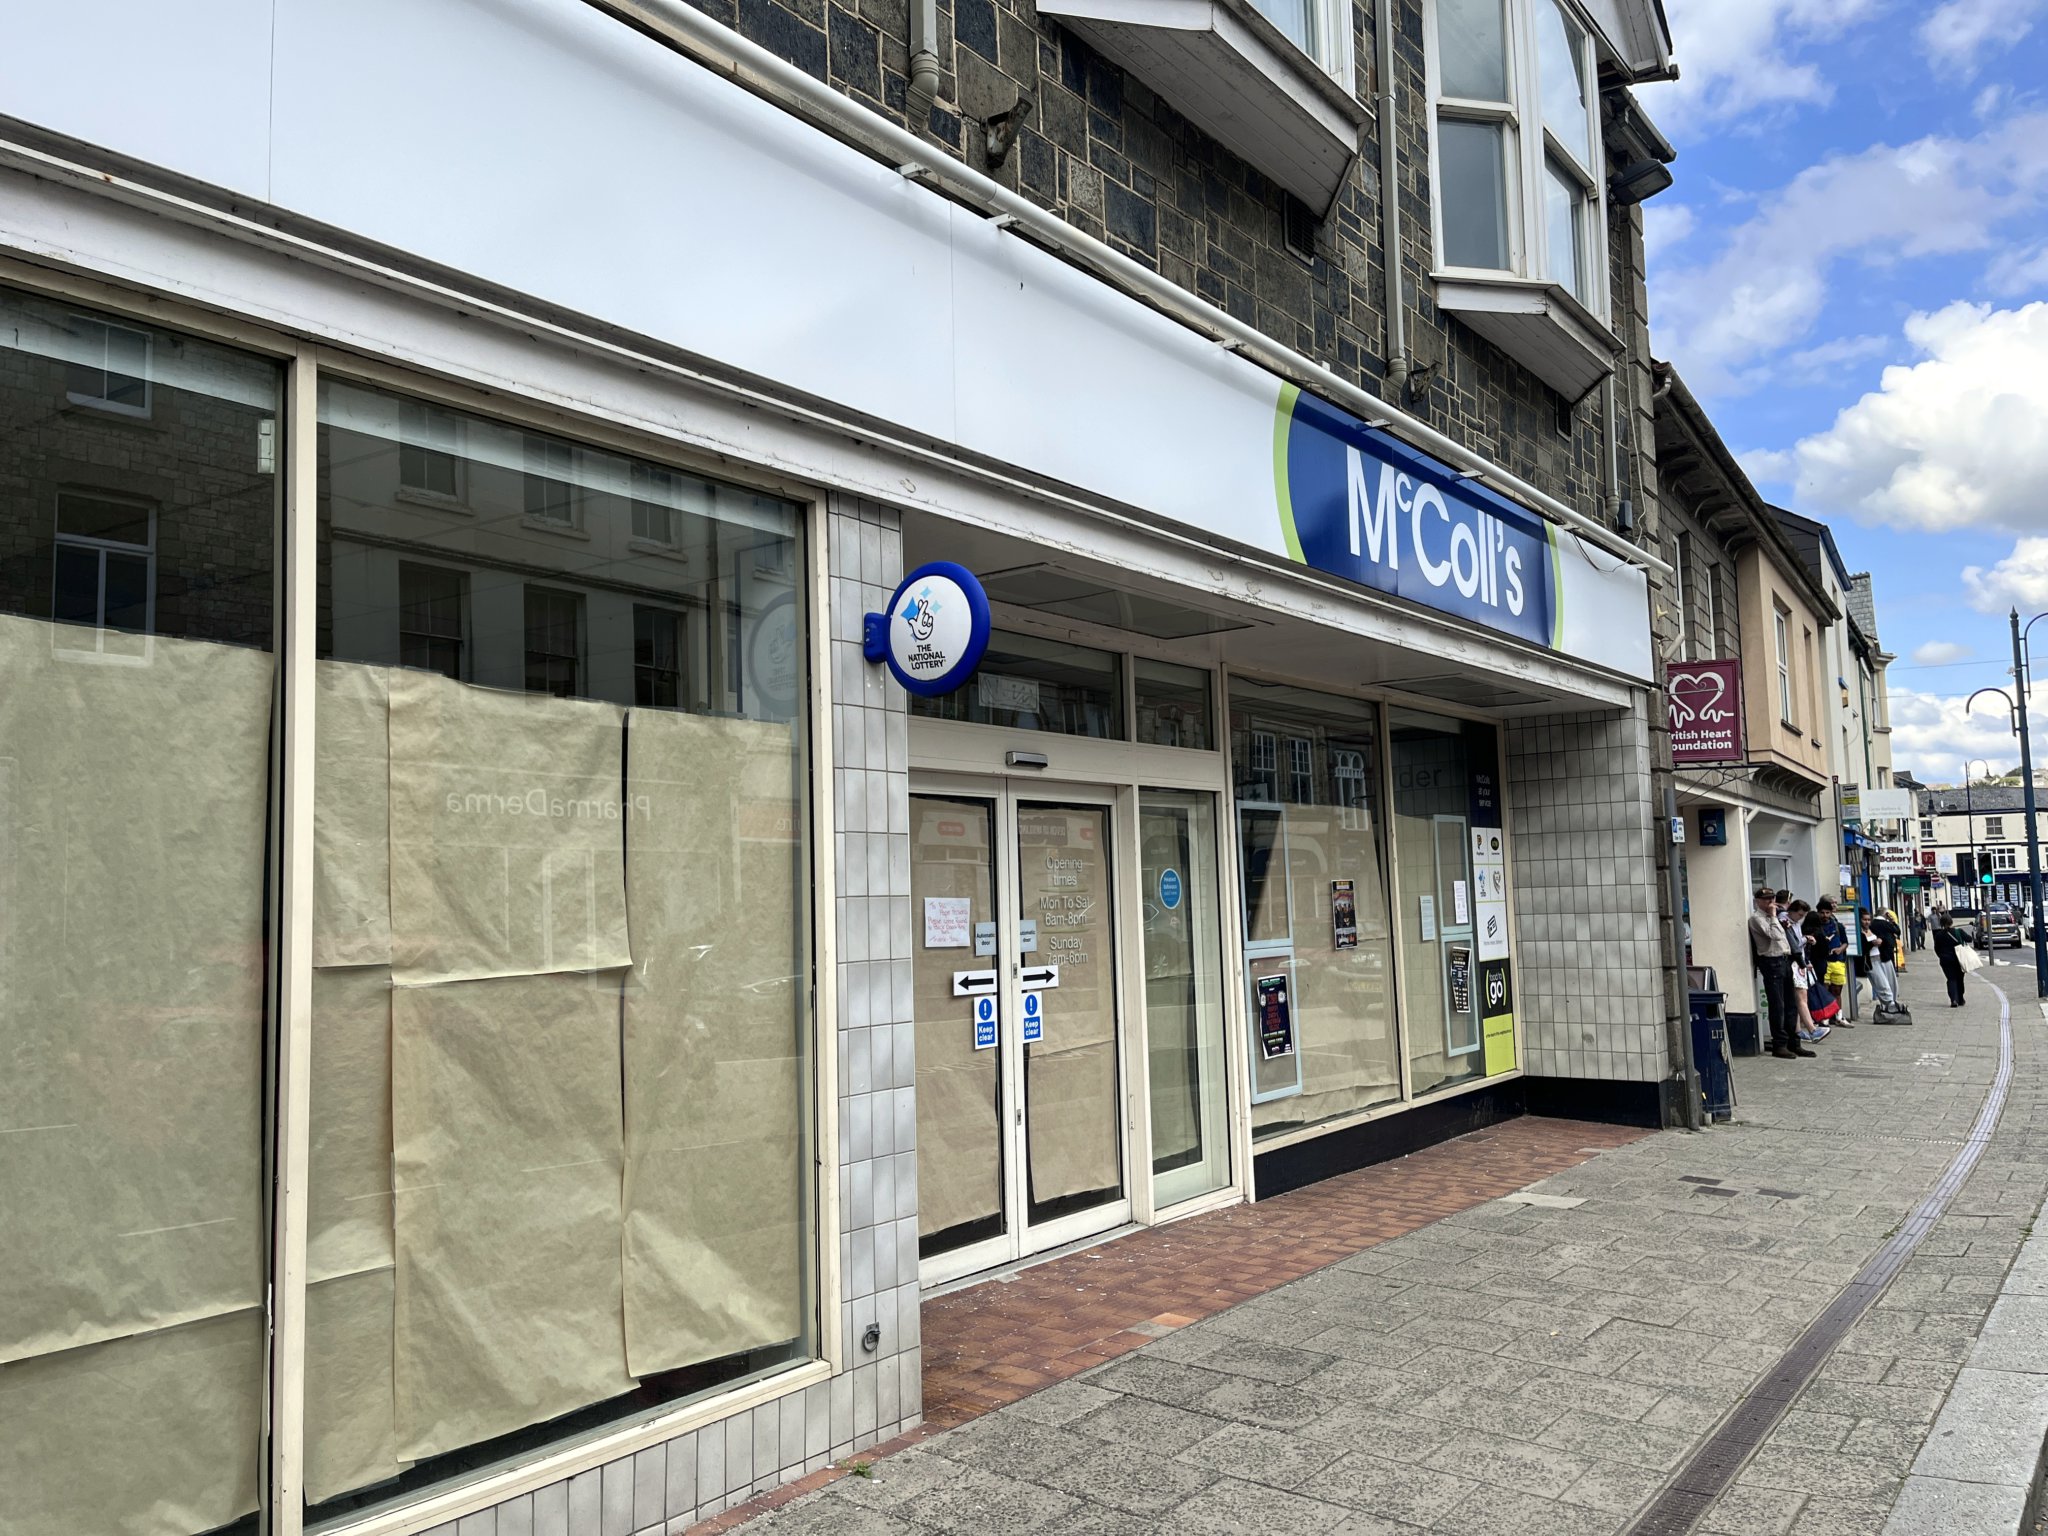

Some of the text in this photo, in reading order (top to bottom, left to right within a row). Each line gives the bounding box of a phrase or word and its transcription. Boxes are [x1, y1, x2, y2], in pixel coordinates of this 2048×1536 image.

[1347, 444, 1524, 617] McColl's
[916, 644, 932, 652] THE
[908, 651, 946, 662] NATIONAL
[911, 660, 944, 670] LOTTERY
[1668, 729, 1732, 740] ritish Heart
[1672, 740, 1732, 751] oundation
[1046, 855, 1083, 872] Opening
[1880, 856, 1912, 864] Bakery
[1053, 874, 1078, 886] times
[1040, 897, 1060, 910] Mon
[1062, 896, 1074, 909] To
[1045, 912, 1087, 927] 6am-8pm
[1050, 936, 1083, 951] Sunday
[1490, 981, 1503, 1005] go
[978, 1026, 993, 1034] Keep
[1024, 1021, 1039, 1029] Keep
[978, 1033, 993, 1042] clear
[1025, 1028, 1039, 1036] clear
